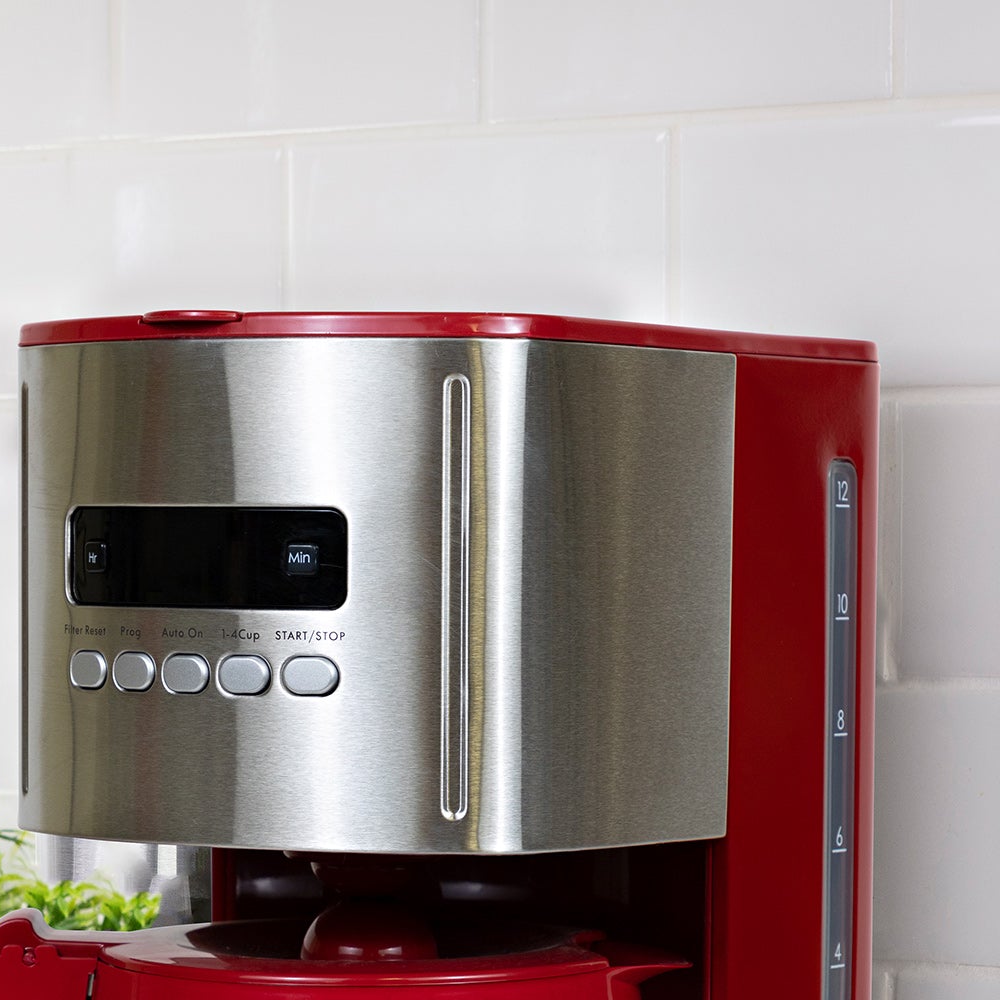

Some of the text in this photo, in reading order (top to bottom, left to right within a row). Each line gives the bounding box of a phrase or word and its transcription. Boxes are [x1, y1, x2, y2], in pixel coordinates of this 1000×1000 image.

[837, 481, 848, 501] 12
[88, 551, 98, 564] Hr
[288, 551, 311, 564] Min
[837, 593, 848, 614] 10
[64, 624, 106, 636] Filter Reset
[120, 626, 141, 640] Prog
[162, 627, 203, 639] Auto On
[221, 629, 260, 642] 1-4Cup
[275, 630, 346, 643] START/STOP
[836, 710, 846, 732] 8
[835, 826, 844, 847] 6
[834, 942, 843, 963] 4
